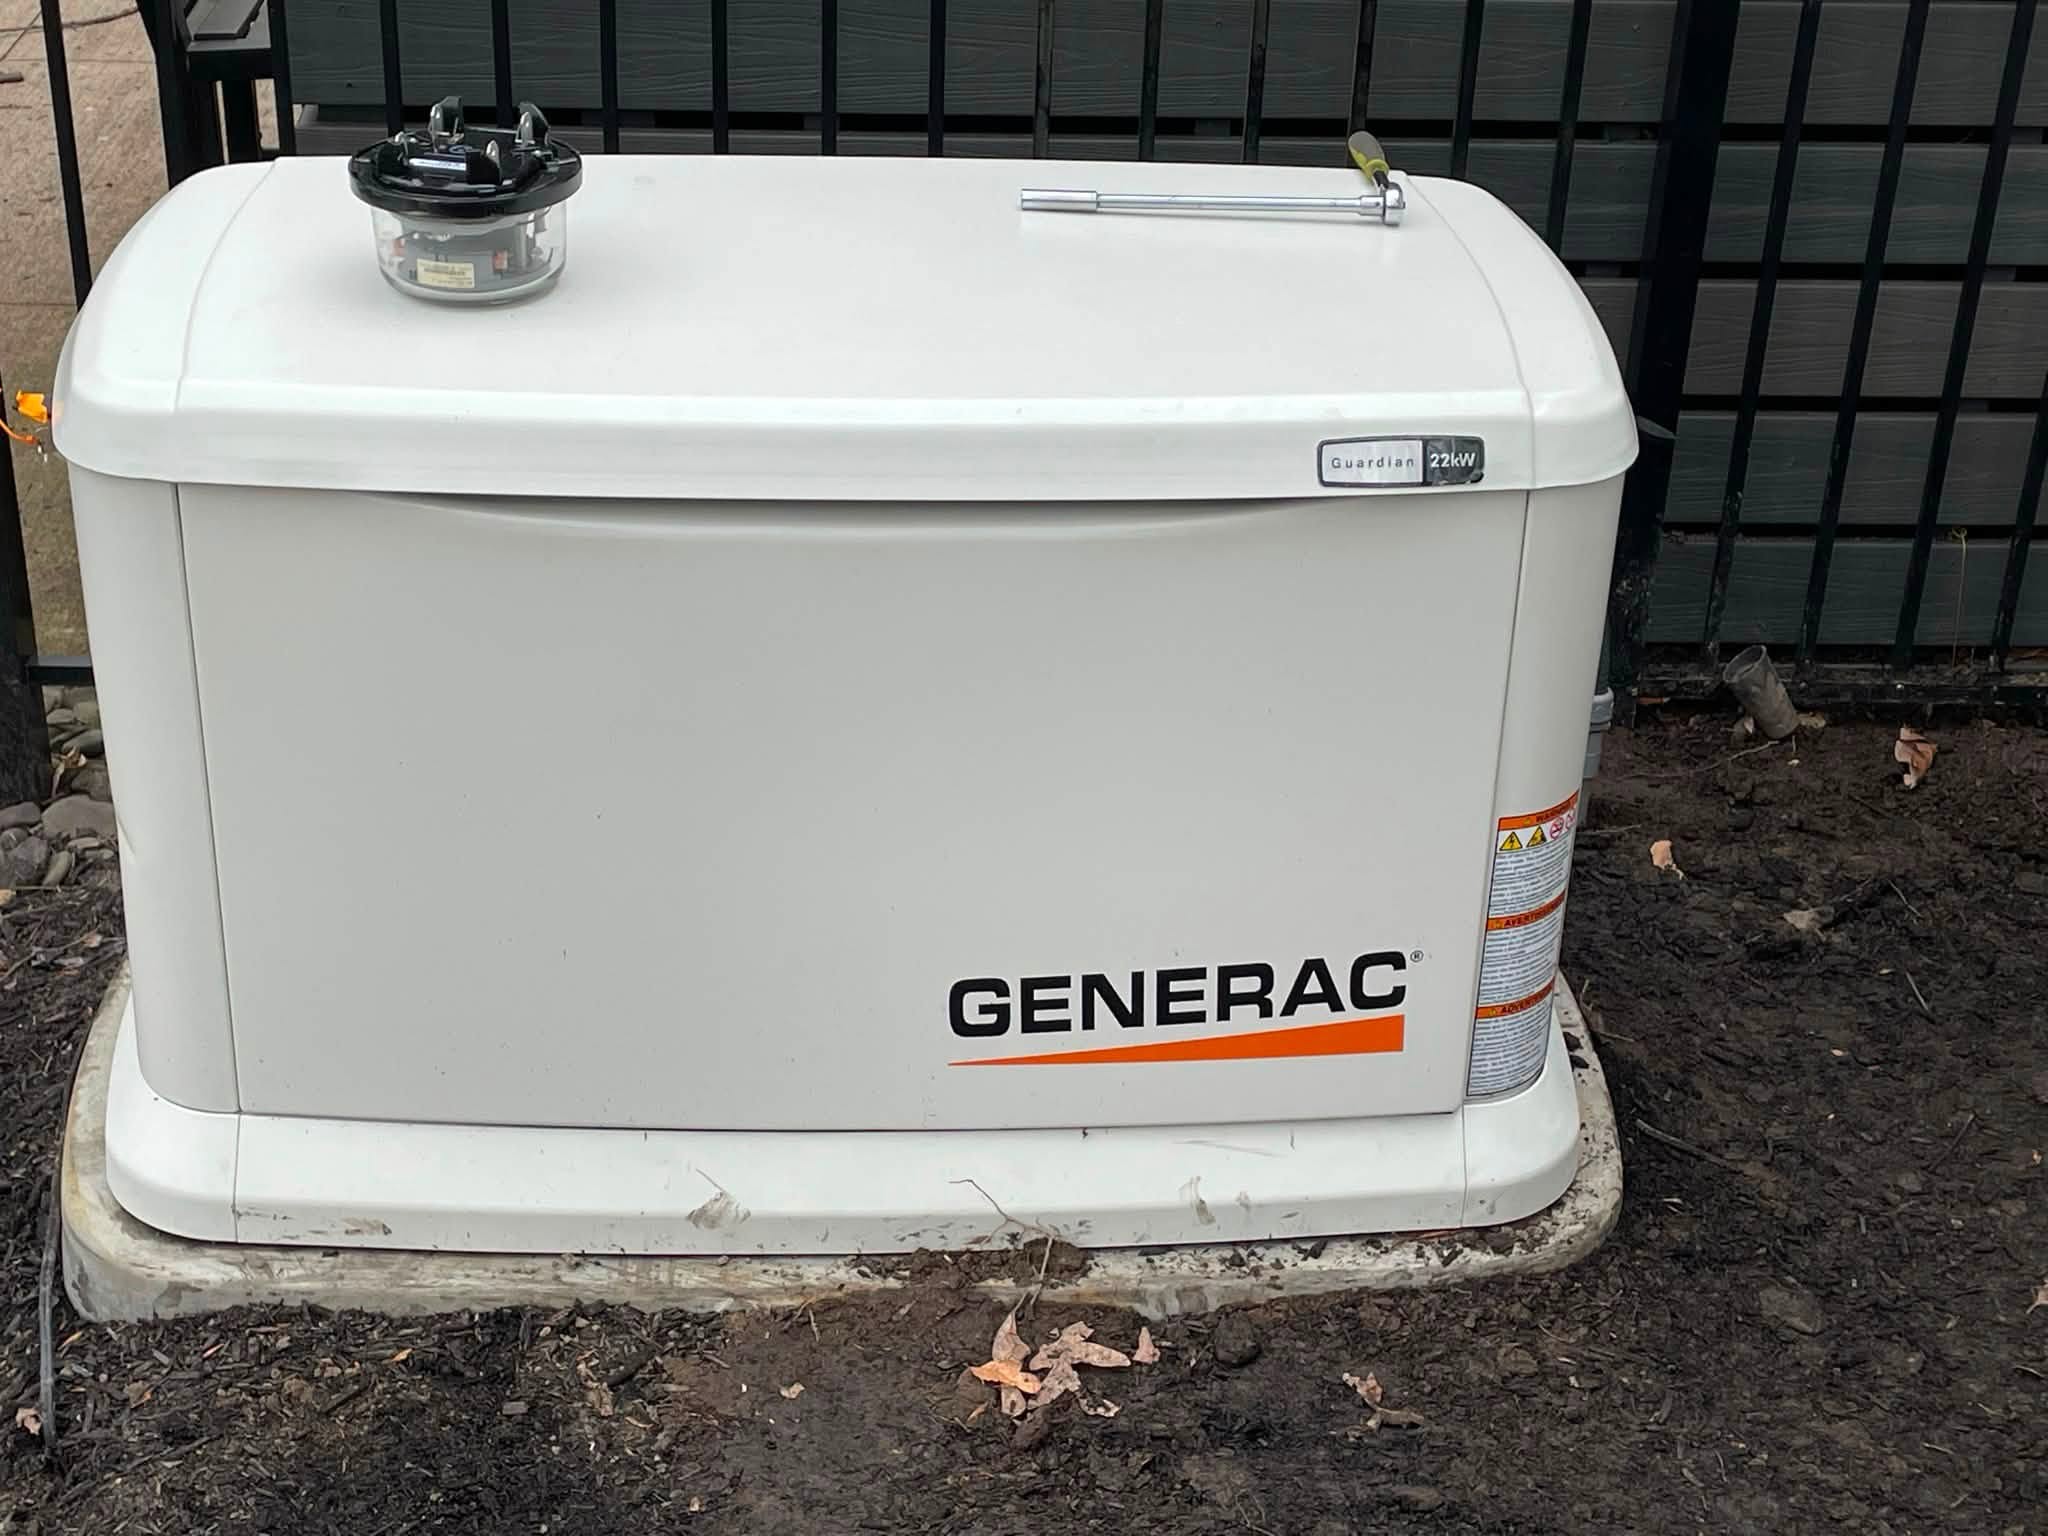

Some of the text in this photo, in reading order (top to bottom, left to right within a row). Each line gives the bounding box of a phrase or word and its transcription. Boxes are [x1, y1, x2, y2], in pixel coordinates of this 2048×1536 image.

[1331, 452, 1476, 469] Guardian 22kW
[949, 951, 1407, 1037] GENERAC
